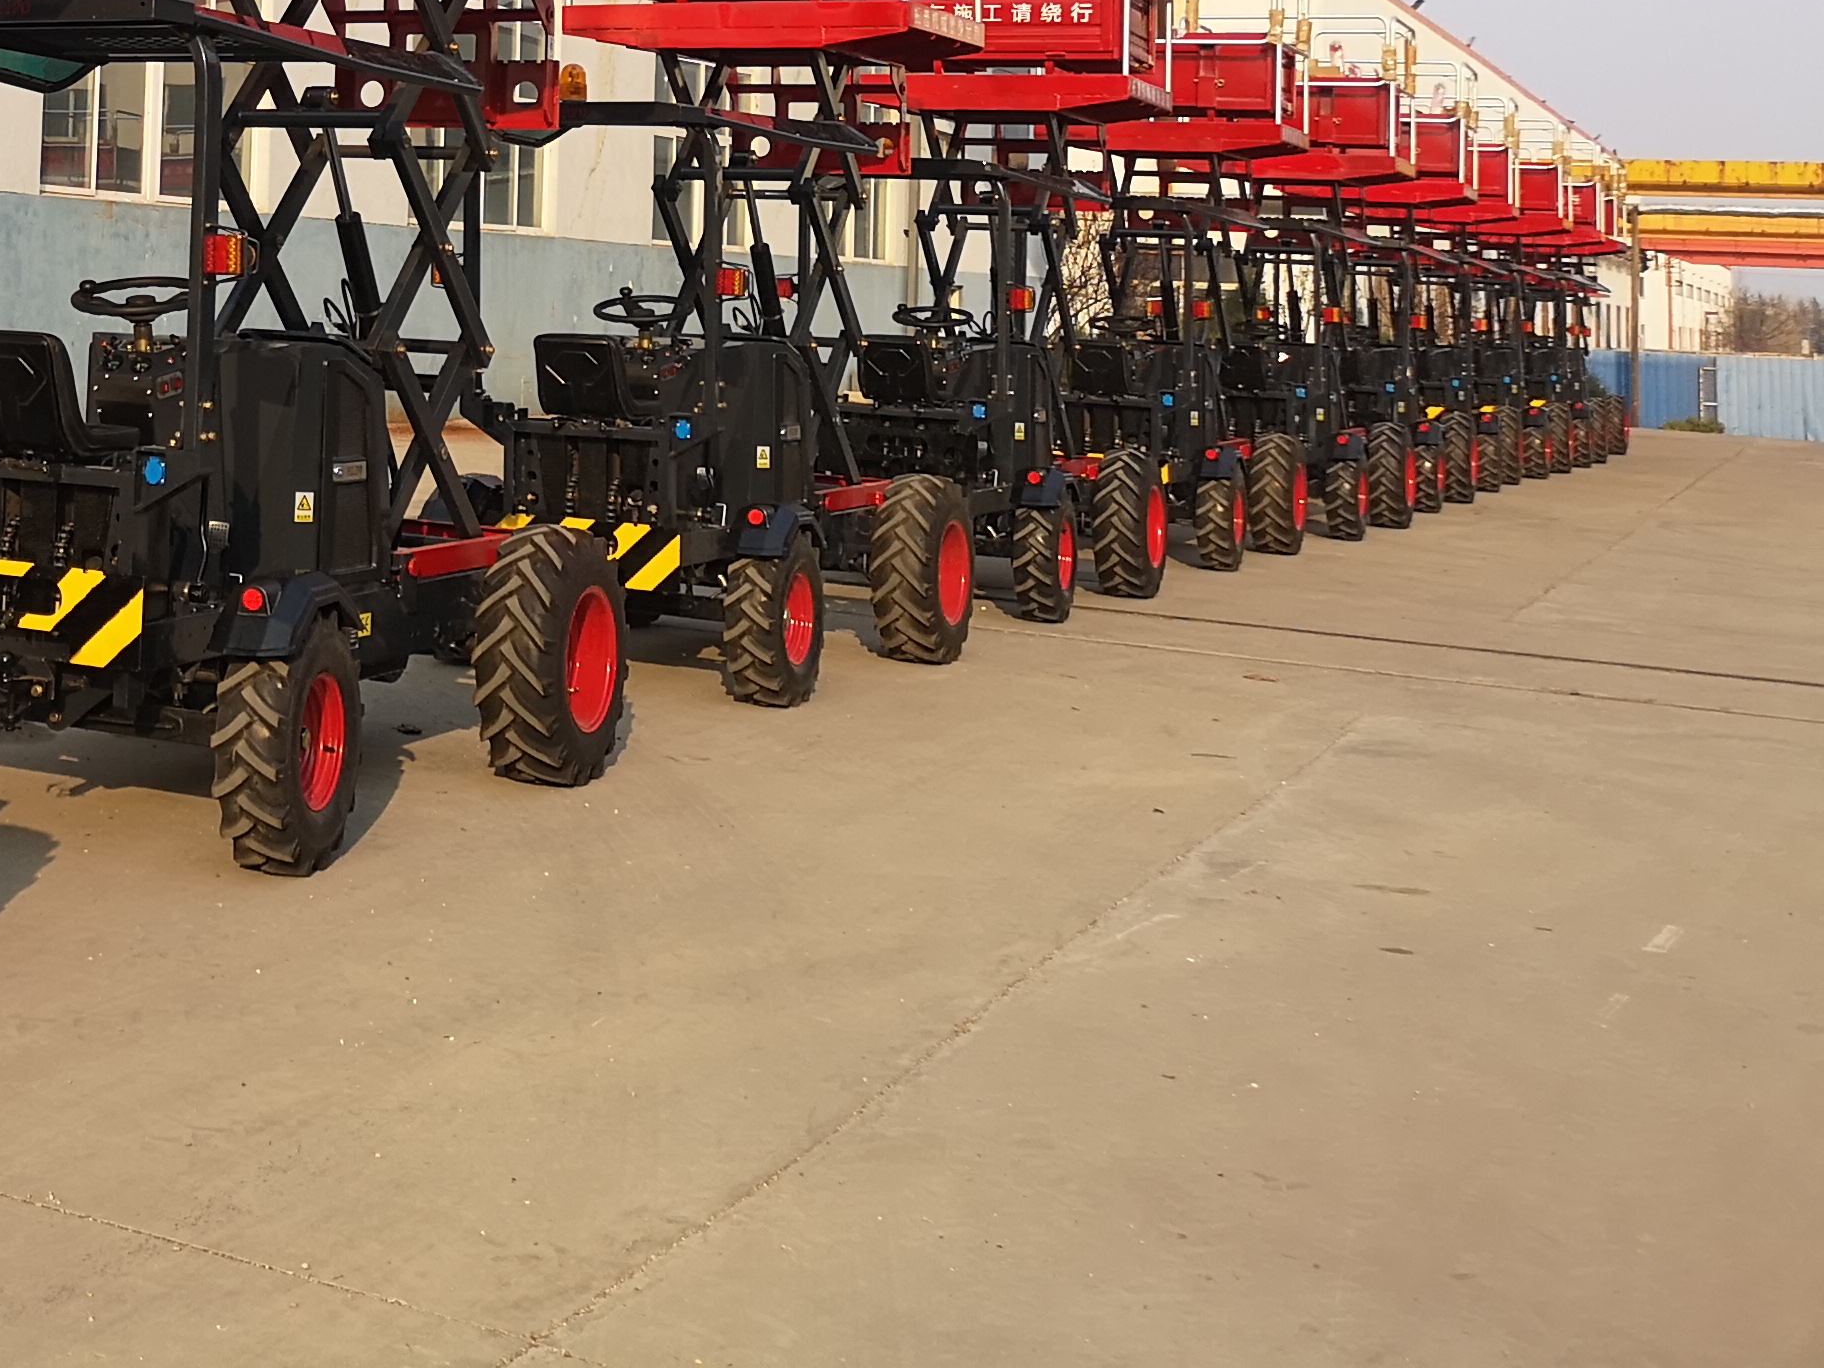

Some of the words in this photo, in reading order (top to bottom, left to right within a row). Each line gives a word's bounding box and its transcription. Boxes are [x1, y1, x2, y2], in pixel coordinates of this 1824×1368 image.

[929, 2, 1094, 24] 施工请绕行
